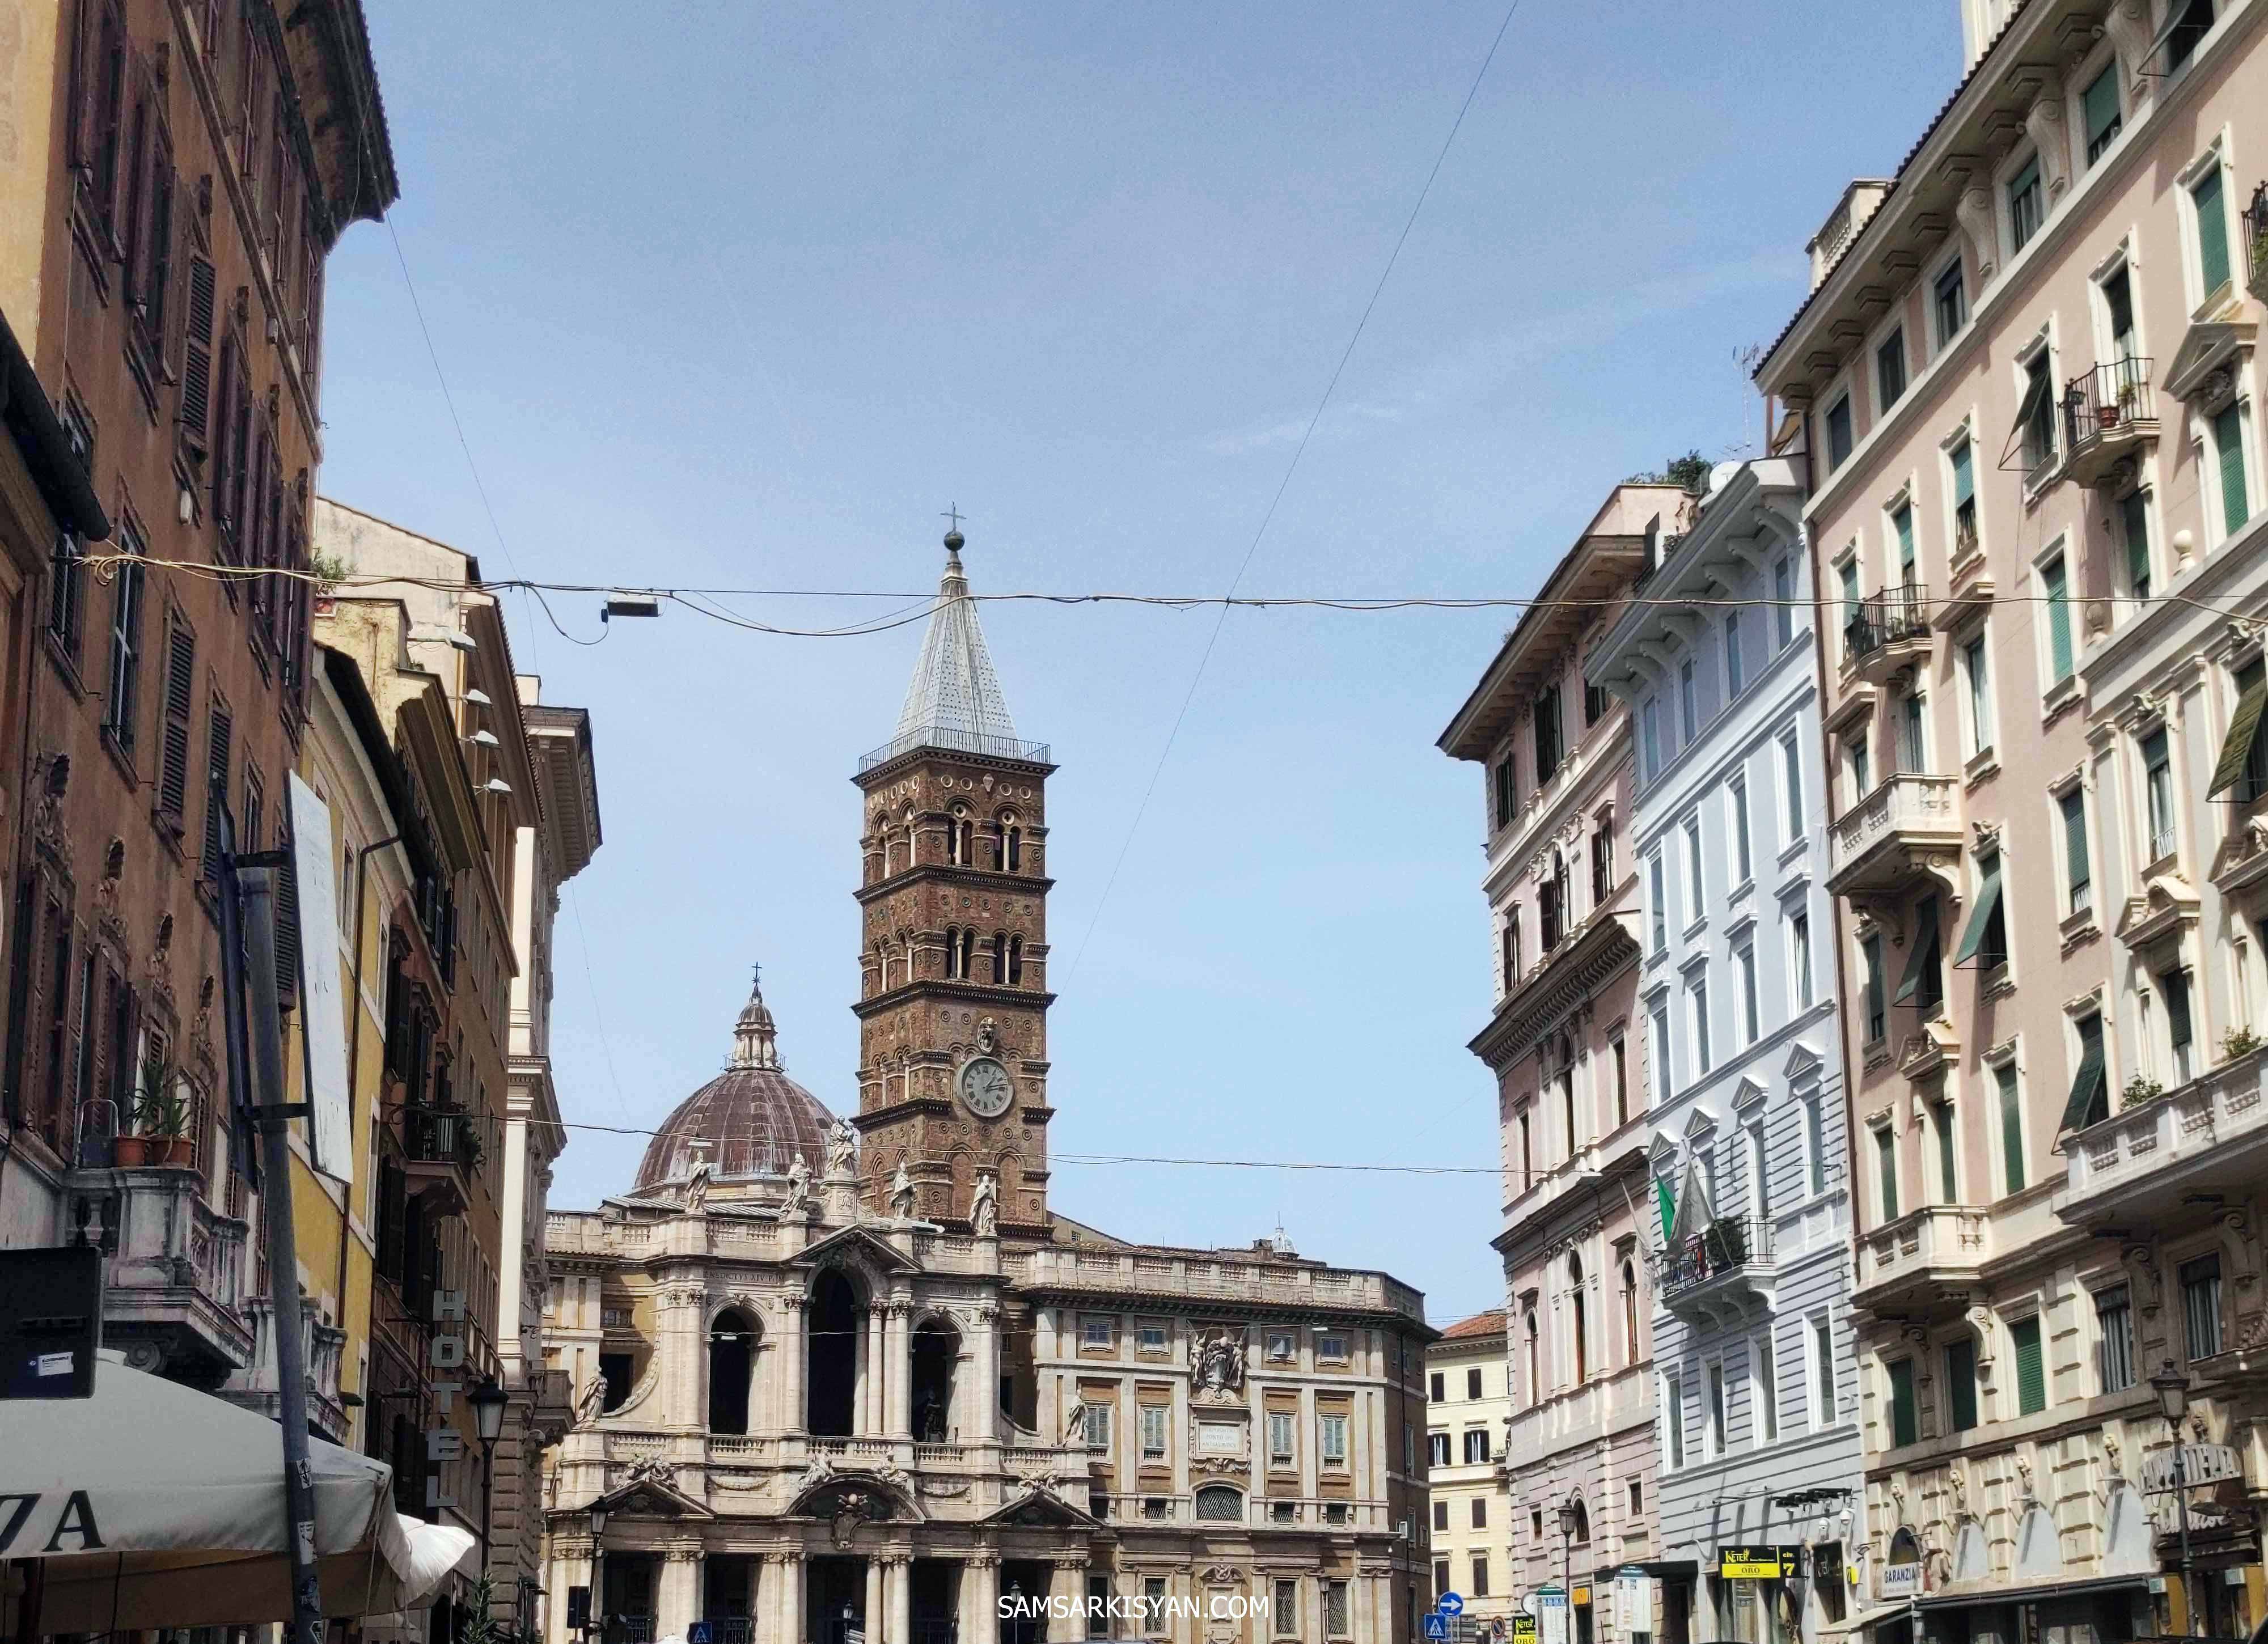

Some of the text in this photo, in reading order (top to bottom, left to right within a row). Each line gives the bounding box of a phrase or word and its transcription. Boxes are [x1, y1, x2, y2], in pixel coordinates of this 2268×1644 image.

[426, 1290, 464, 1507] HOTEL
[1783, 1562, 1795, 1576] 7
[1884, 1566, 1916, 1583] GARANZIA
